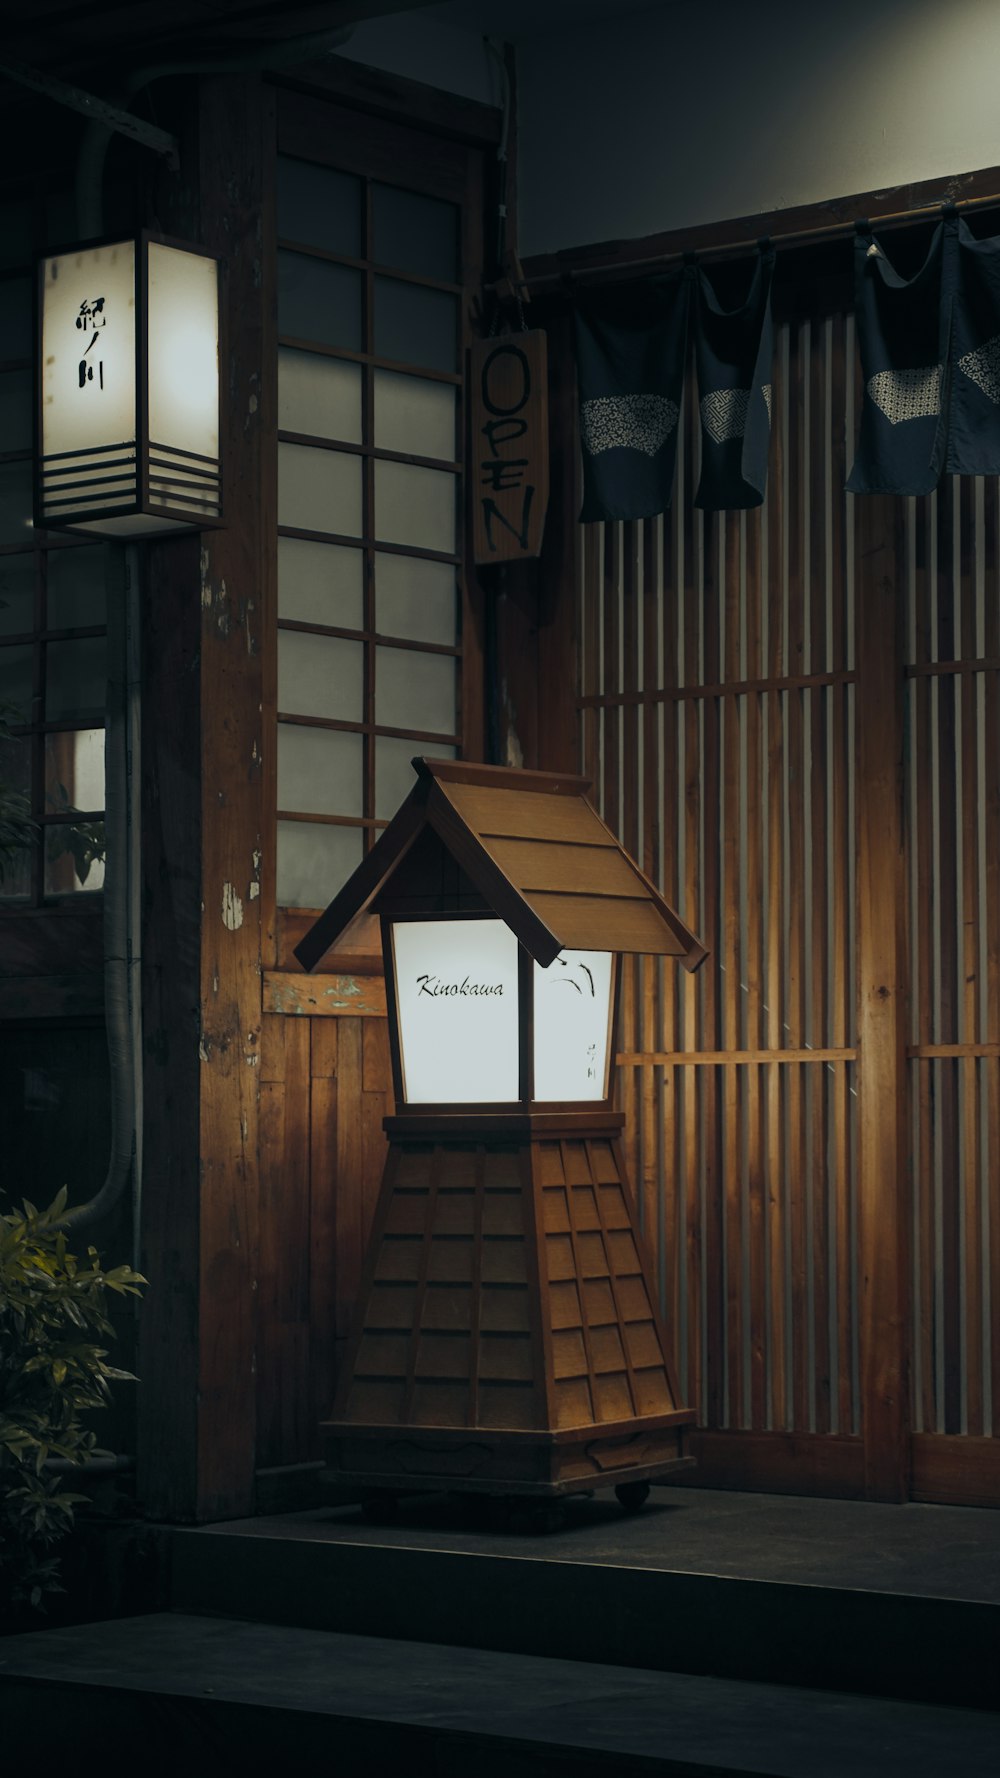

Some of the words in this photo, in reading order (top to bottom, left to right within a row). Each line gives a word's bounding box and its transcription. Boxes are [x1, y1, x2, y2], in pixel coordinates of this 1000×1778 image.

[76, 298, 105, 390] 紀ノ川
[481, 344, 535, 552] OPEN
[416, 975, 503, 997] Kinokawa
